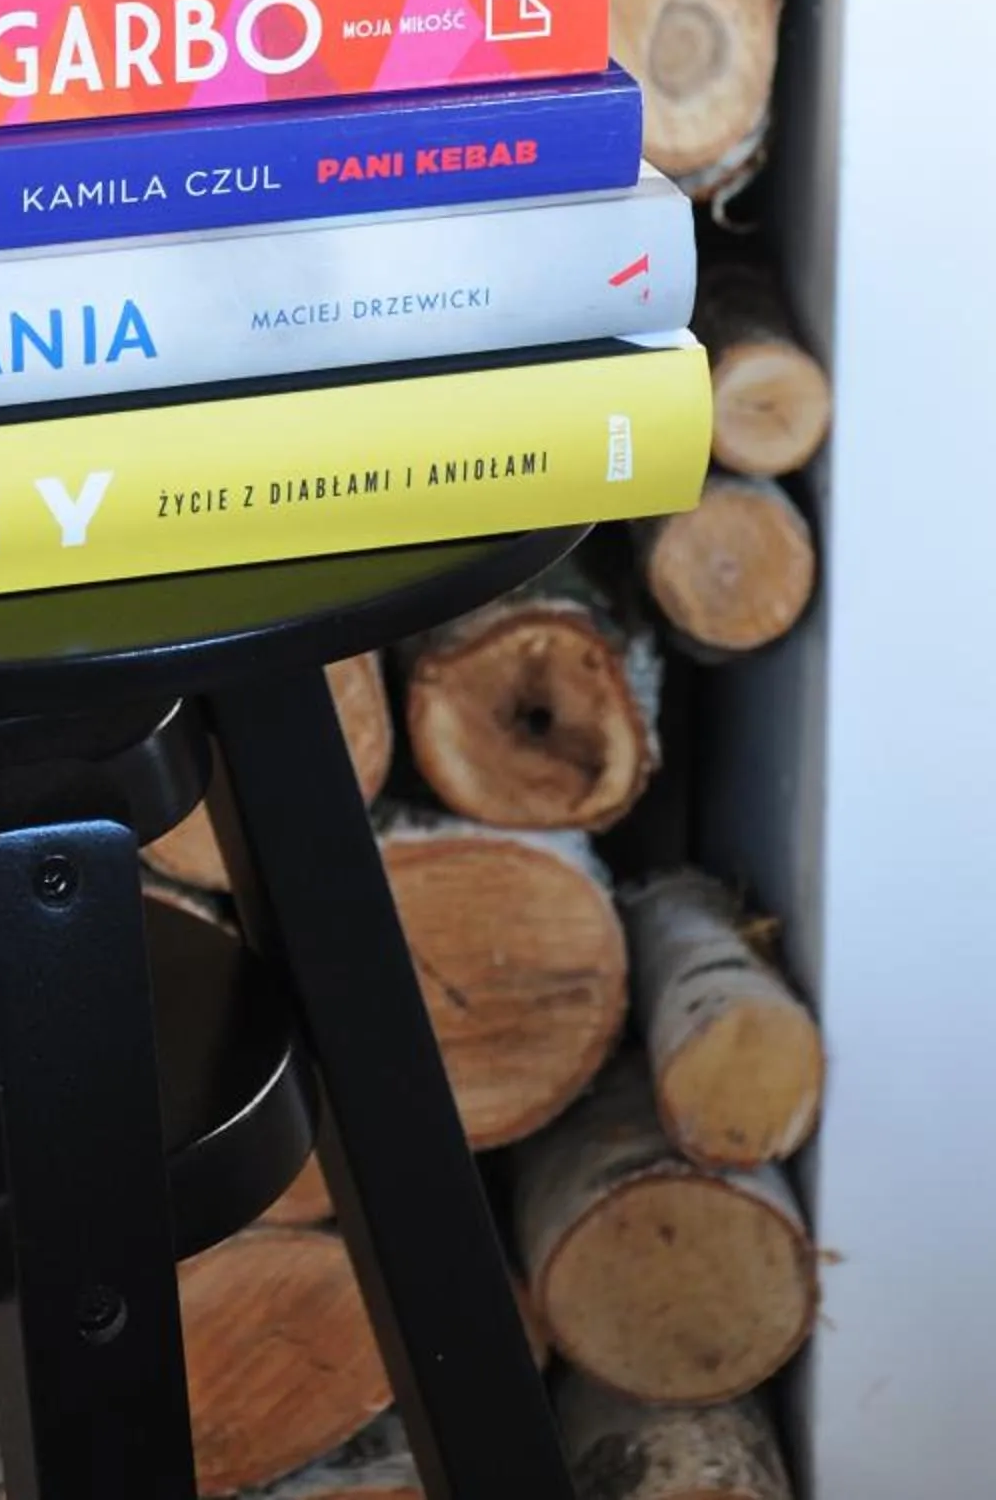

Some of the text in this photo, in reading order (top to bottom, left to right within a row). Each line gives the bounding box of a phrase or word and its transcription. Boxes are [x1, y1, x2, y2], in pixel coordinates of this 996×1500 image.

[342, 9, 468, 40] MOJA MIŁOŚĆ
[316, 140, 539, 183] PANI KEBAB
[22, 164, 282, 213] KAMILA CZUL
[250, 286, 493, 331] MACIEJ DRZEWICKI
[157, 450, 549, 518] ŻYCIE Z DIABŁAMI I ANIOŁAMI
